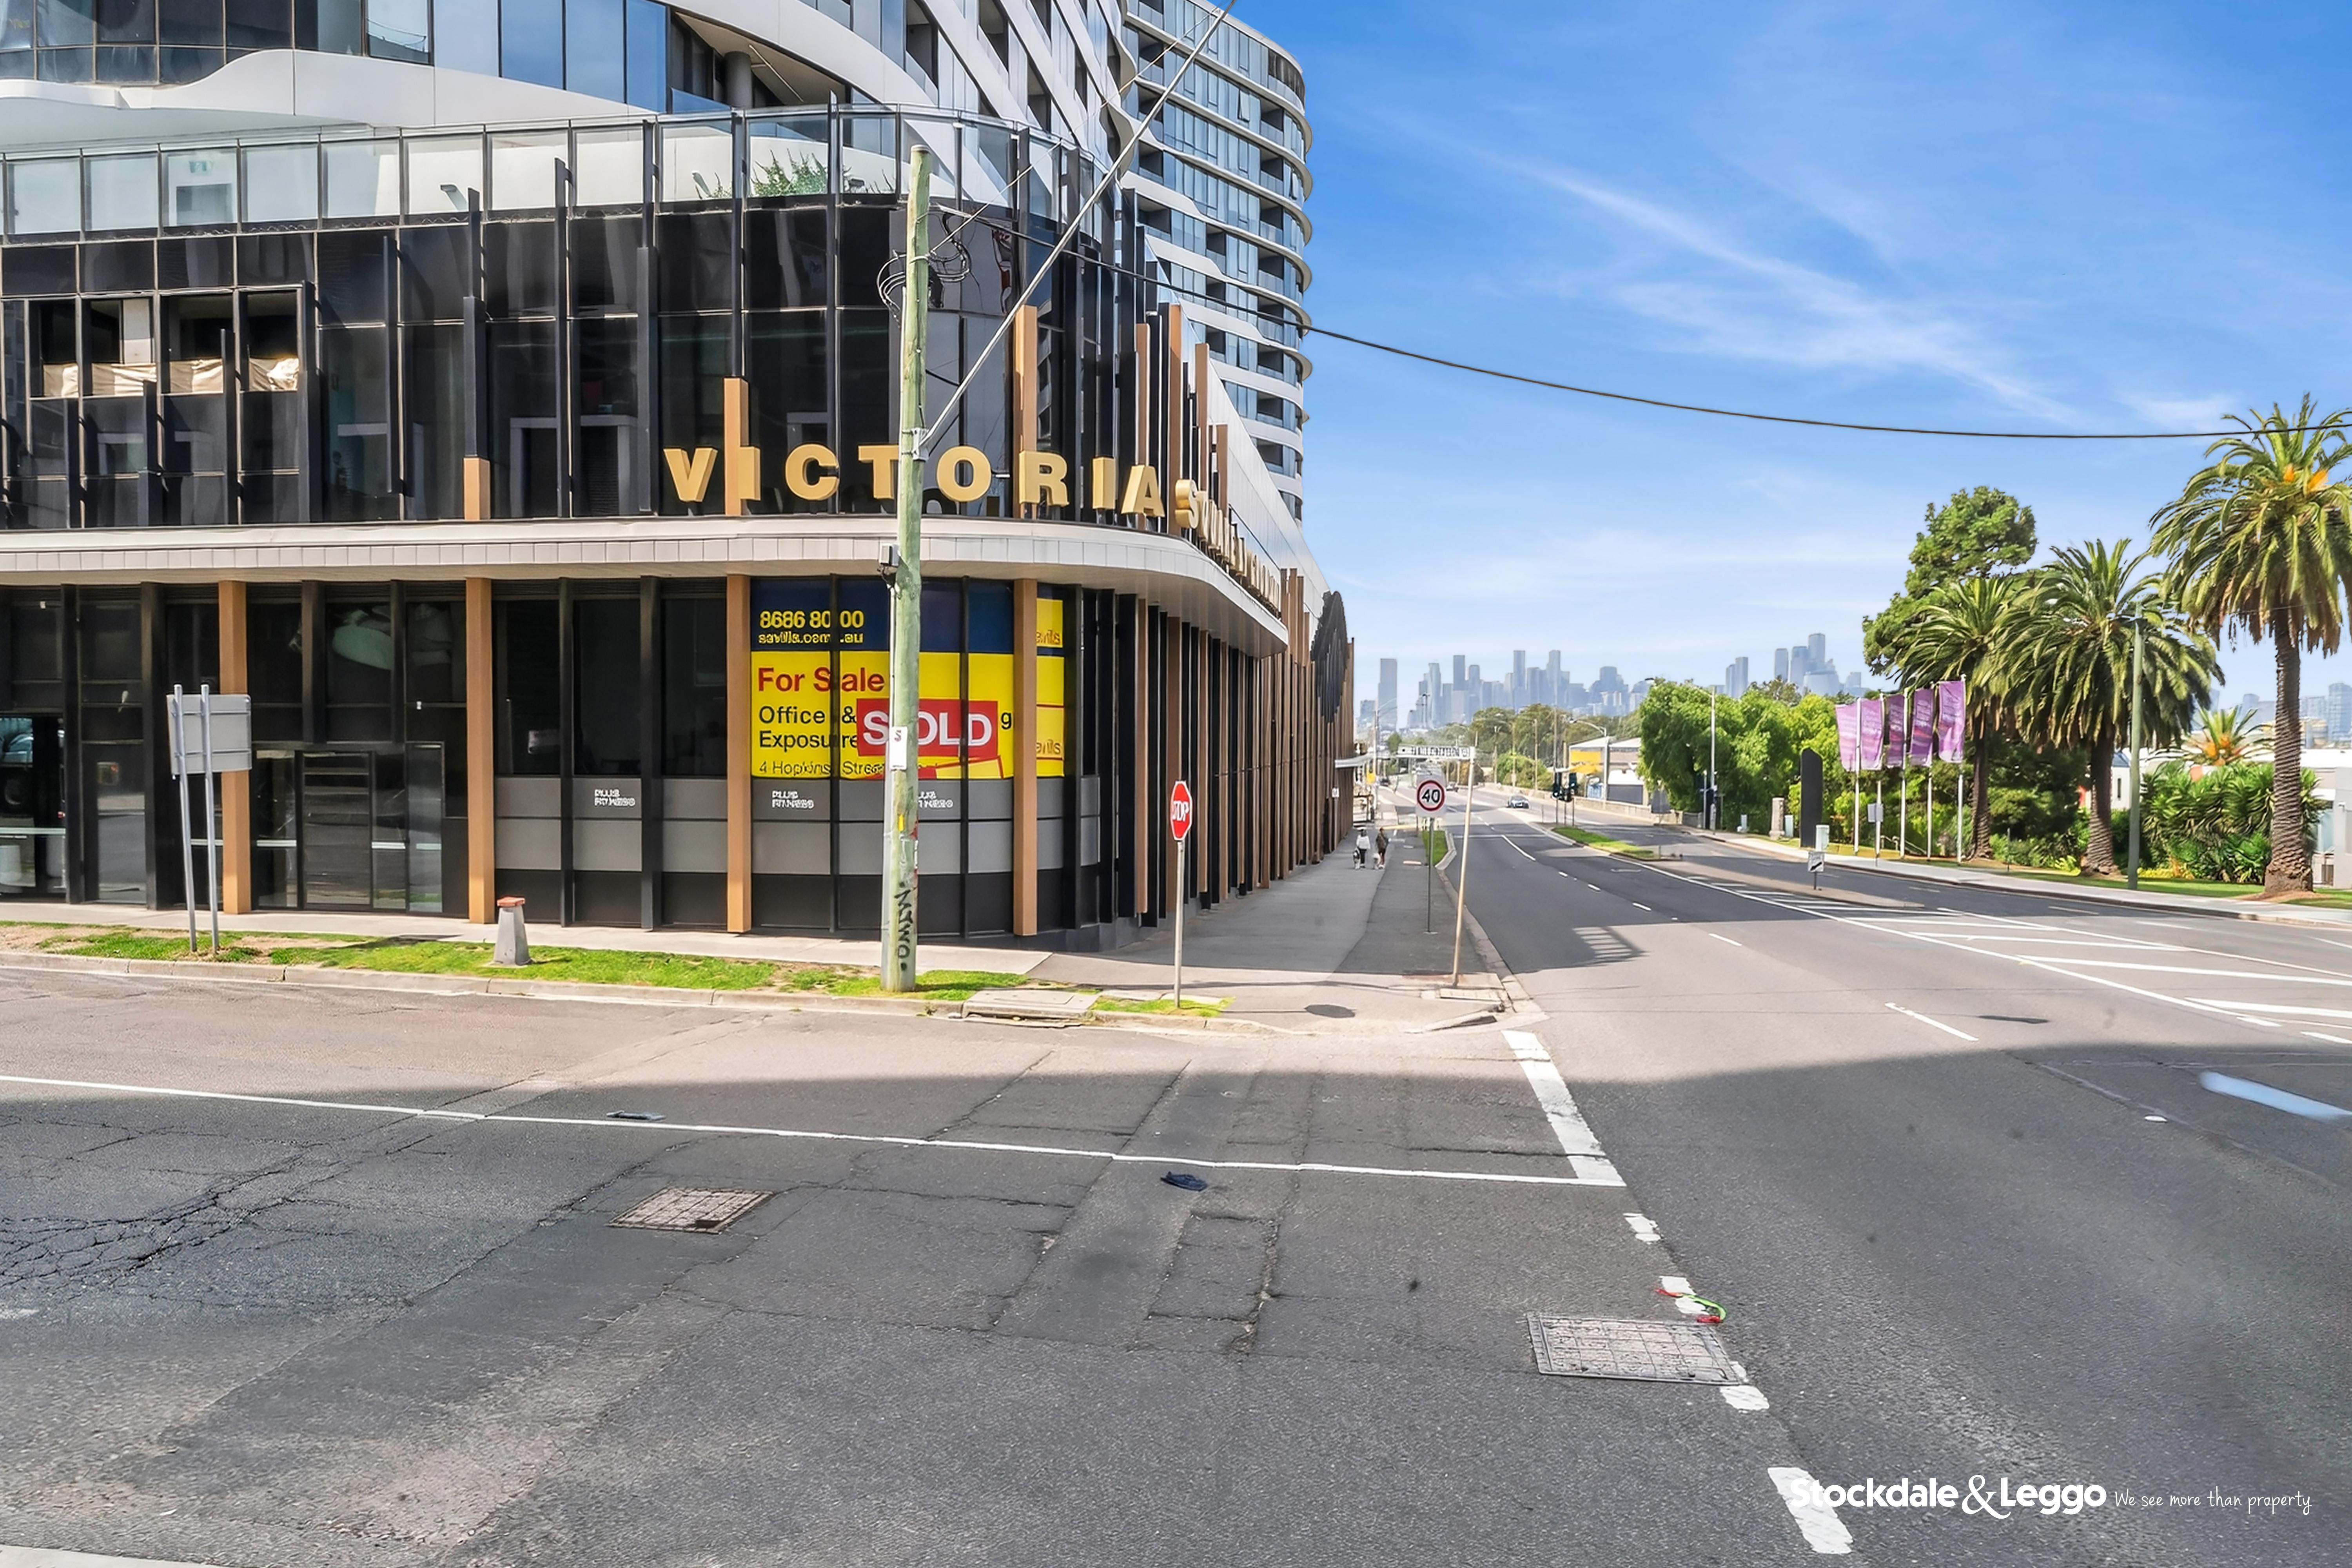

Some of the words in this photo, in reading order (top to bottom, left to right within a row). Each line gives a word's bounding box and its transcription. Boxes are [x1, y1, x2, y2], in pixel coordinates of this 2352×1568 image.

[663, 443, 1165, 518] VICTORIA
[759, 610, 806, 628] 8686
[758, 667, 805, 691] For
[813, 667, 885, 691] Sale
[759, 706, 825, 724] Office
[842, 706, 857, 724] &
[863, 710, 992, 746] SOLD
[1422, 789, 1440, 803] 40
[1172, 800, 1189, 822] STOP
